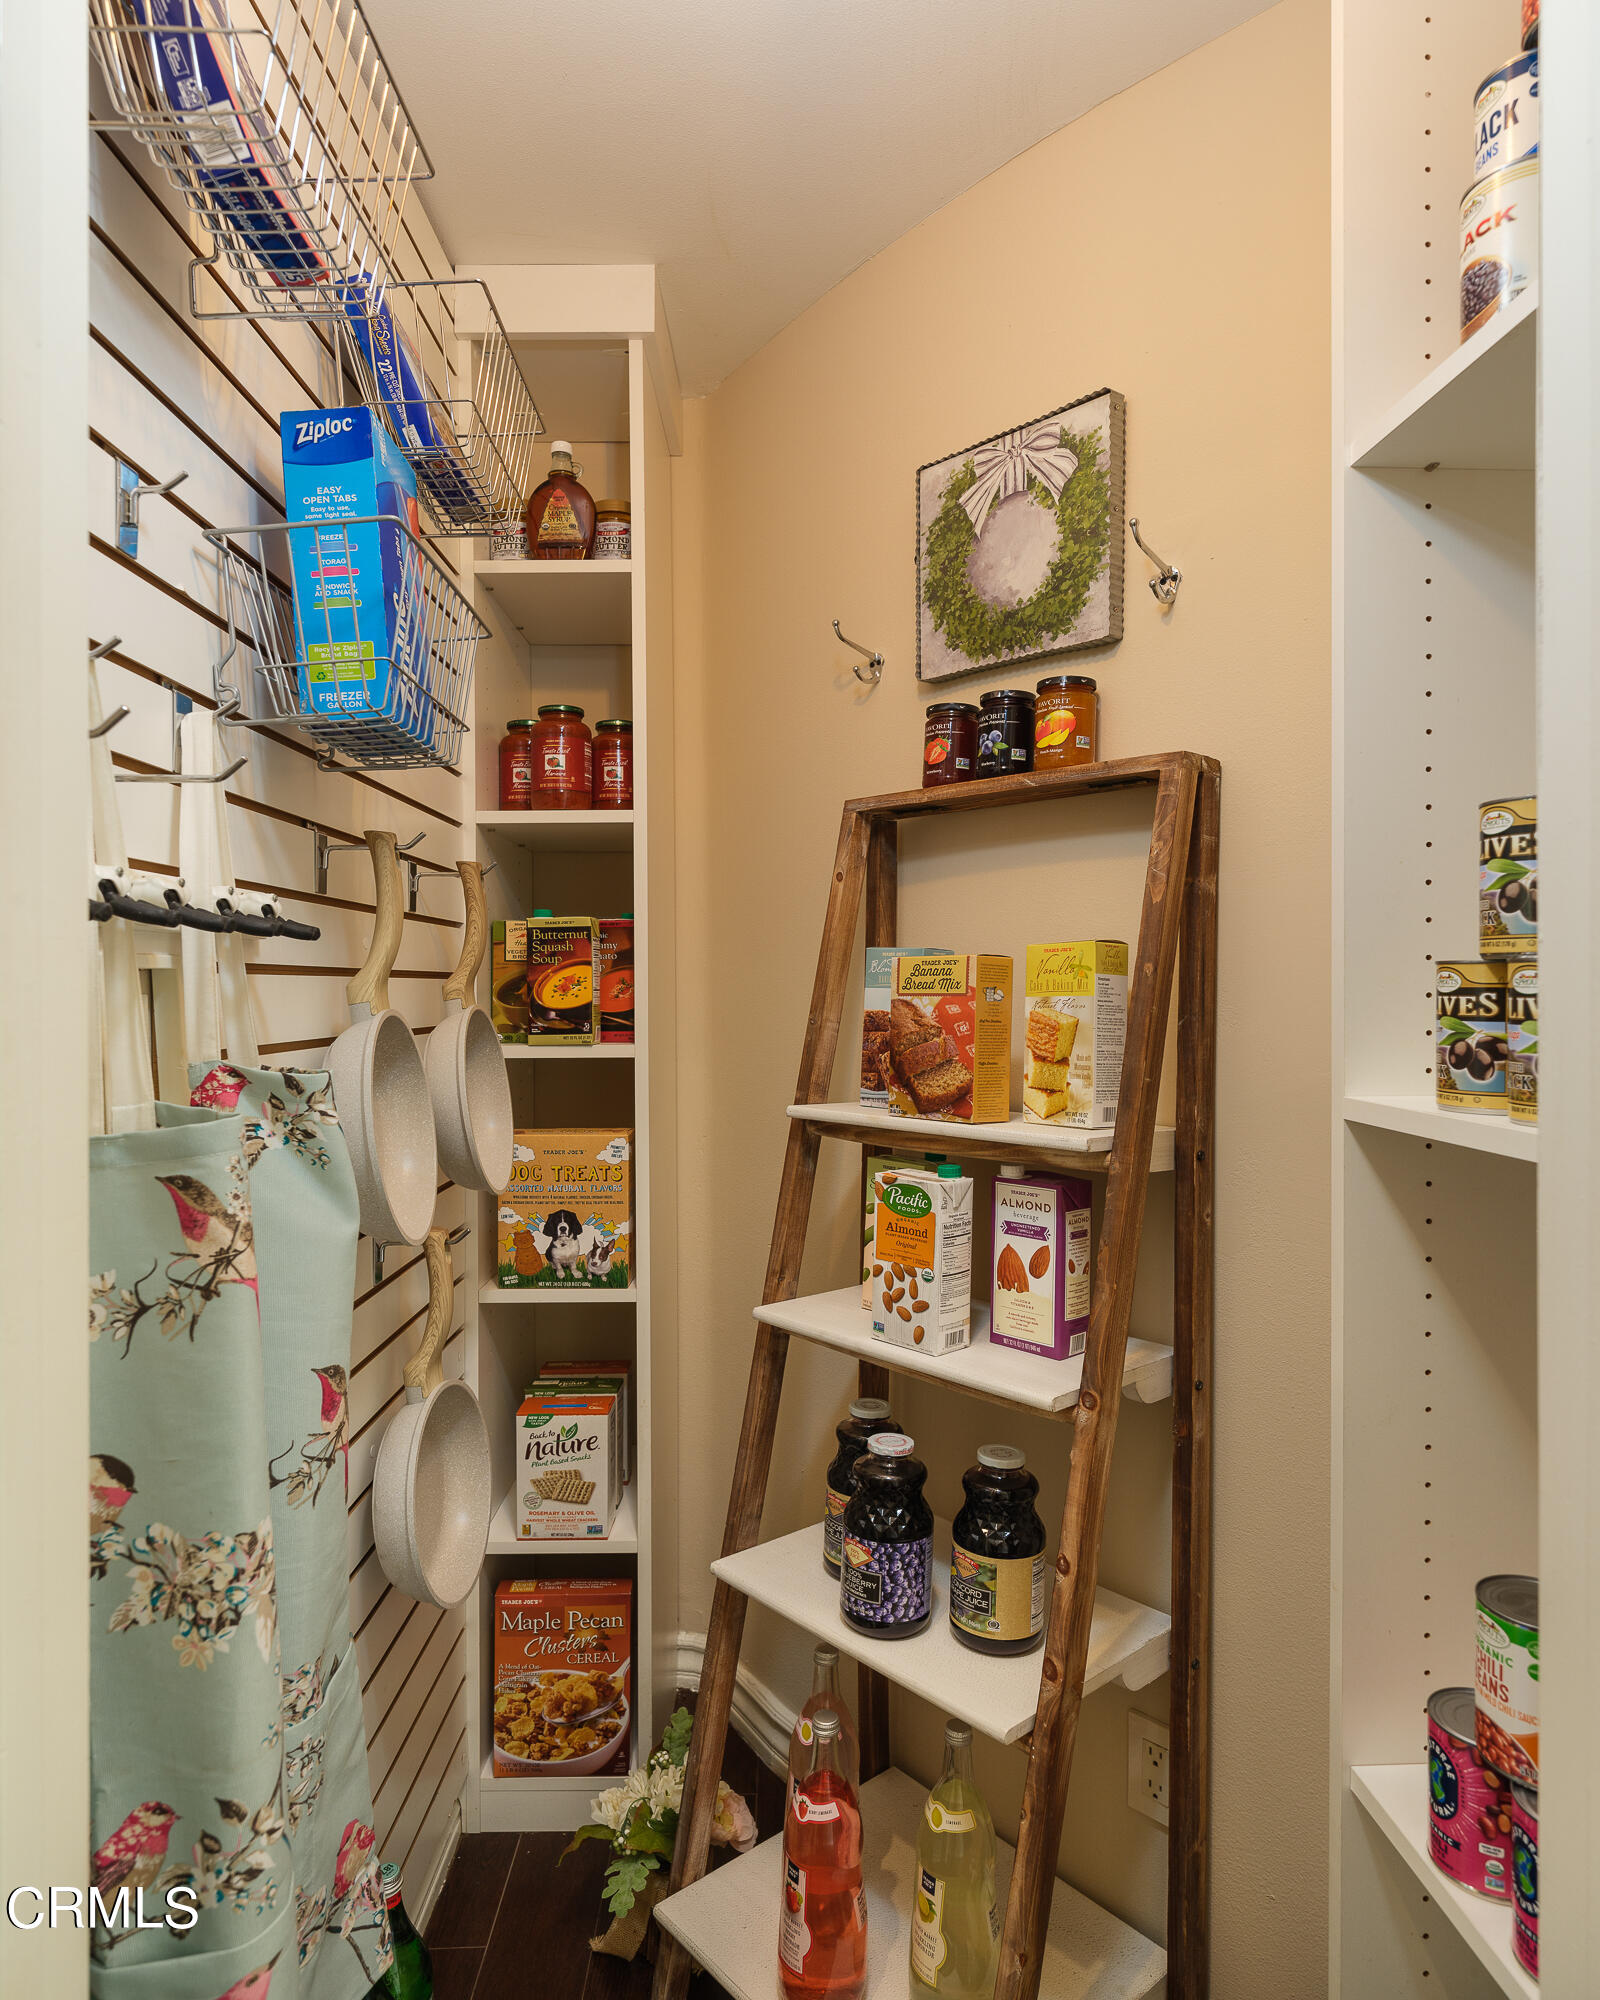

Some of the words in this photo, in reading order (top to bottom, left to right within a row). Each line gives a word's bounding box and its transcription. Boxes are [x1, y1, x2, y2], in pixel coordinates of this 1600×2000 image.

[1460, 203, 1517, 257] ACK
[375, 330, 391, 356] Sheets
[376, 358, 393, 375] 22
[295, 417, 353, 445] Ziploc
[317, 486, 341, 495] EASY
[302, 496, 330, 505] OPEN
[333, 494, 358, 503] TABS
[1480, 833, 1537, 861] IVE
[533, 929, 589, 940] Butternut
[532, 941, 574, 954] Squash
[532, 953, 563, 966] Soup
[1036, 954, 1077, 980] Vanilla
[910, 963, 953, 977] Banana
[902, 977, 936, 991] Bread
[938, 978, 961, 992] Mix
[1029, 979, 1043, 992] Cake
[1045, 979, 1050, 991] &
[1052, 979, 1074, 992] Baking
[1077, 977, 1089, 990] Mix
[1438, 992, 1499, 1017] IVES
[551, 1165, 624, 1182] TREATS
[505, 1184, 544, 1193] ASSORTED
[548, 1184, 587, 1193] NATURAL
[590, 1184, 624, 1193] FLAVORS
[887, 1187, 929, 1209] Pacific
[1001, 1197, 1051, 1213] ALMOND
[897, 1206, 920, 1214] FOODS
[1013, 1210, 1039, 1222] beverage
[896, 1218, 920, 1226] ORGANIC
[943, 1222, 961, 1230] Nutrition
[1068, 1216, 1089, 1226] ALMOND
[886, 1222, 928, 1239] Almond
[896, 1240, 917, 1249] Original
[529, 1430, 548, 1440] Back
[548, 1429, 556, 1437] to
[525, 1433, 599, 1461] nature
[531, 1460, 549, 1468] Plant
[570, 1453, 592, 1462] Snacks
[965, 1596, 989, 1609] JUICE
[501, 1611, 561, 1634] Maple
[568, 1611, 624, 1631] Pecan
[524, 1633, 599, 1657] Clusters
[1477, 1635, 1513, 1668] RGANIC
[567, 1652, 620, 1664] CEREAL
[1517, 1711, 1539, 1726] SAUC
[1429, 1739, 1456, 1782] STBRAE
[1430, 1821, 1454, 1846] GANIC
